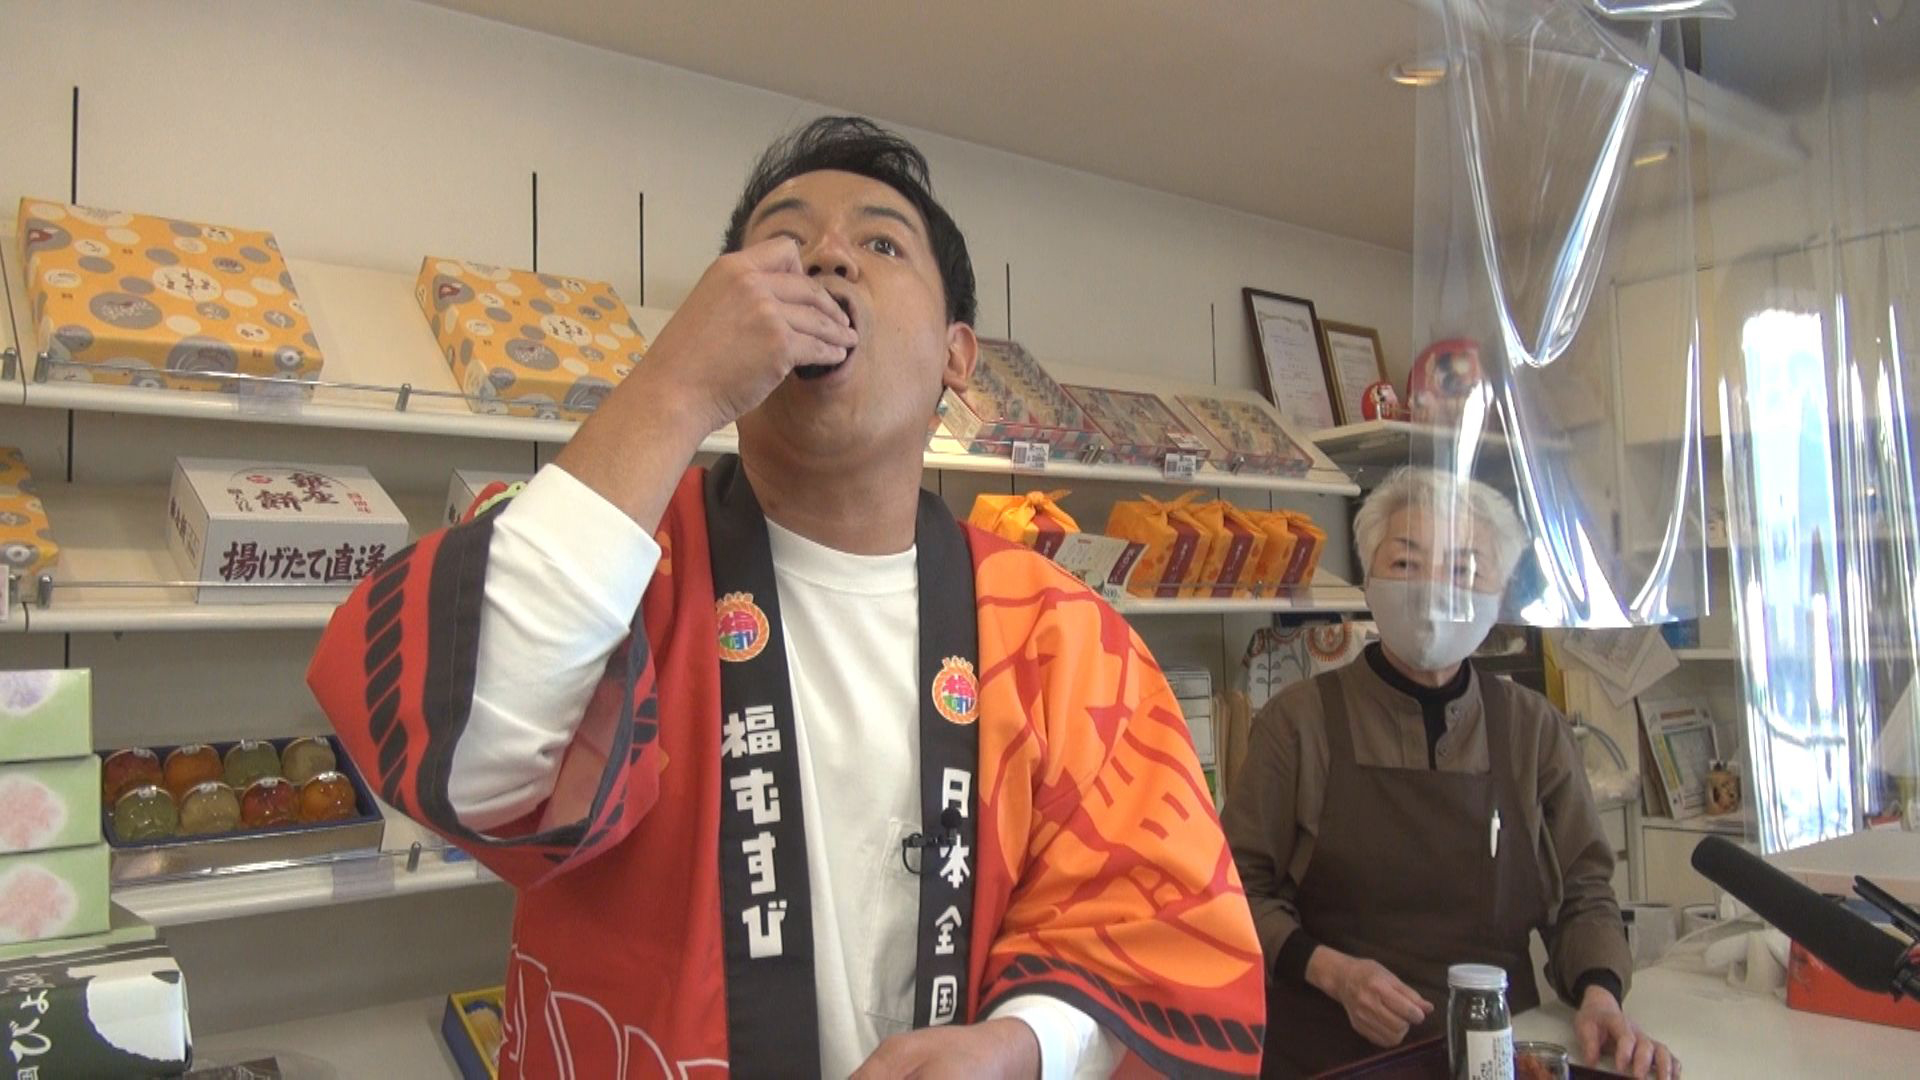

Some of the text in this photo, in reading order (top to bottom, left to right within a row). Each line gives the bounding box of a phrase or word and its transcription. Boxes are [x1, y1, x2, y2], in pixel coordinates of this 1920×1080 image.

[219, 541, 386, 583] 揚げたて直送
[722, 704, 788, 959] 福むすび
[929, 766, 972, 1026] 日本全国
